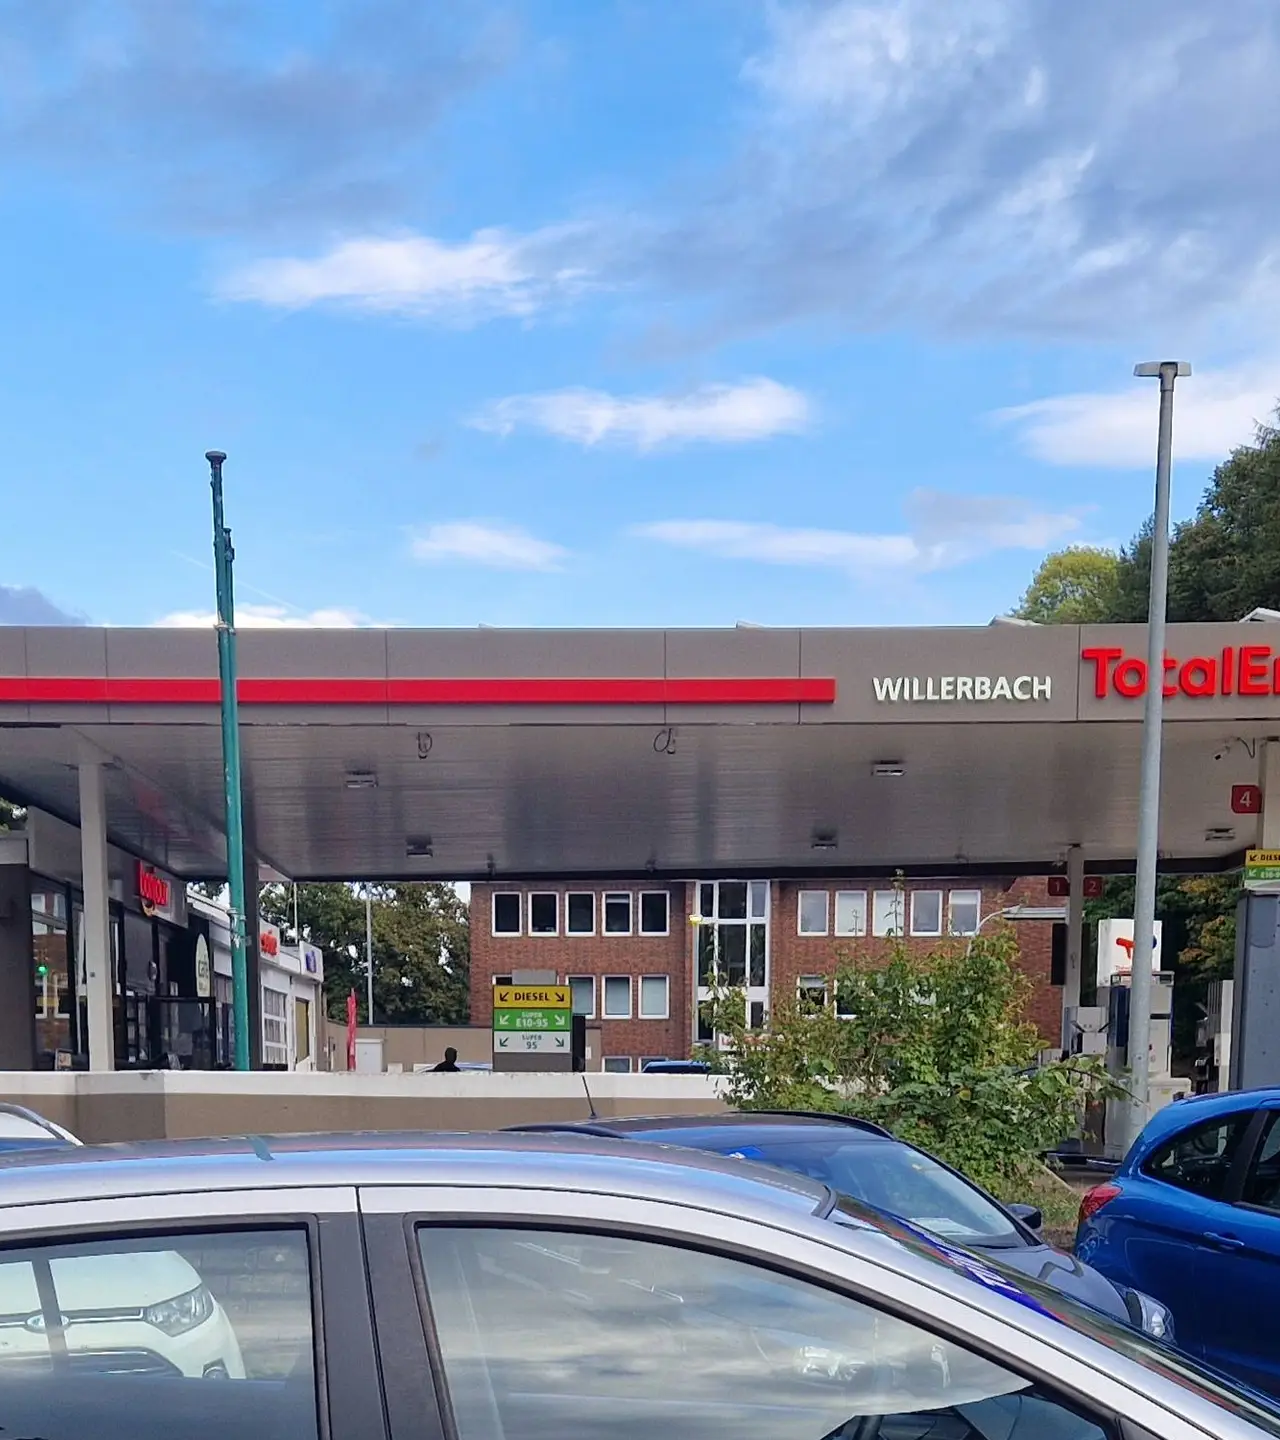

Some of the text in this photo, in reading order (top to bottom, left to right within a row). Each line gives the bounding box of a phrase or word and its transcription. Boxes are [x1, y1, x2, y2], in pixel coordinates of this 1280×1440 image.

[872, 675, 1052, 702] WILLERBACH
[1239, 790, 1252, 808] 4
[1088, 881, 1098, 893] 2
[514, 992, 550, 1001] DIESEL
[515, 1019, 549, 1028] E10-95
[525, 1041, 539, 1050] 95
